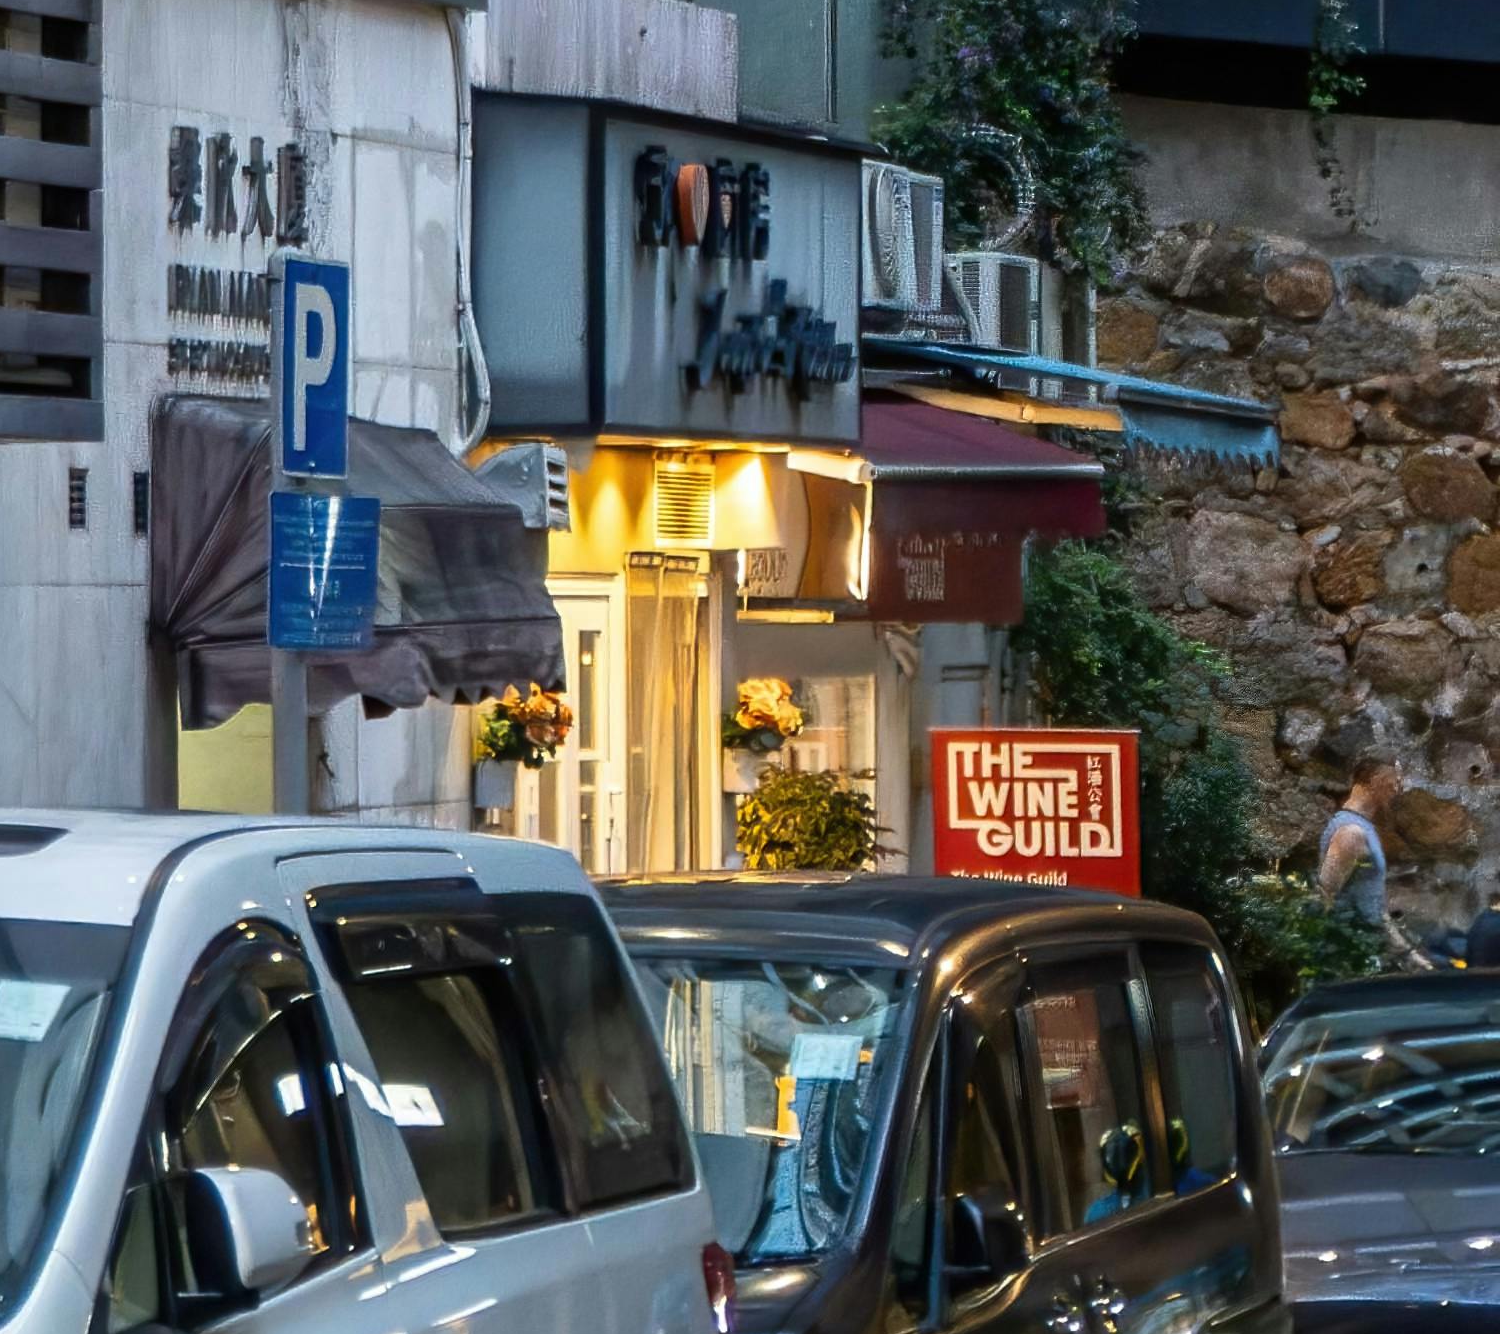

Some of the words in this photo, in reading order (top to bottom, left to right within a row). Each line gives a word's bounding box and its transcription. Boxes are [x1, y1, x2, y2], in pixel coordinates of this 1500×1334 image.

[293, 283, 336, 451] P
[958, 742, 1034, 779] THE
[967, 781, 1080, 817] WINE
[977, 821, 1113, 857] GUILD
[1027, 871, 1068, 886] Guild
